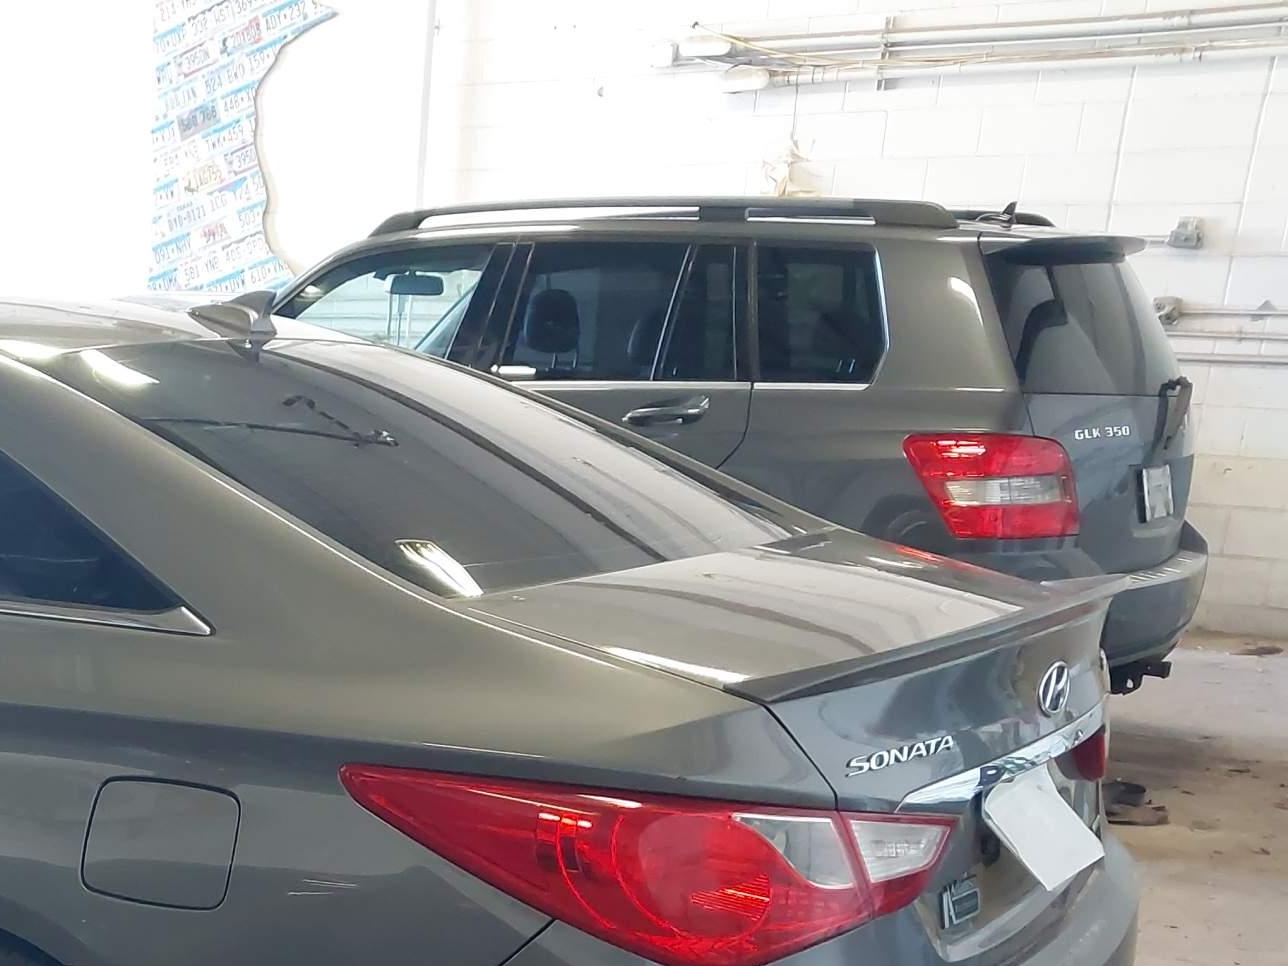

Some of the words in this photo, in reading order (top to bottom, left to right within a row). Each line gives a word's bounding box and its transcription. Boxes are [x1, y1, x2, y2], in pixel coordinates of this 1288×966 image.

[1074, 429, 1101, 440] GLK
[1105, 425, 1131, 437] 350
[846, 734, 954, 778] SONATA
